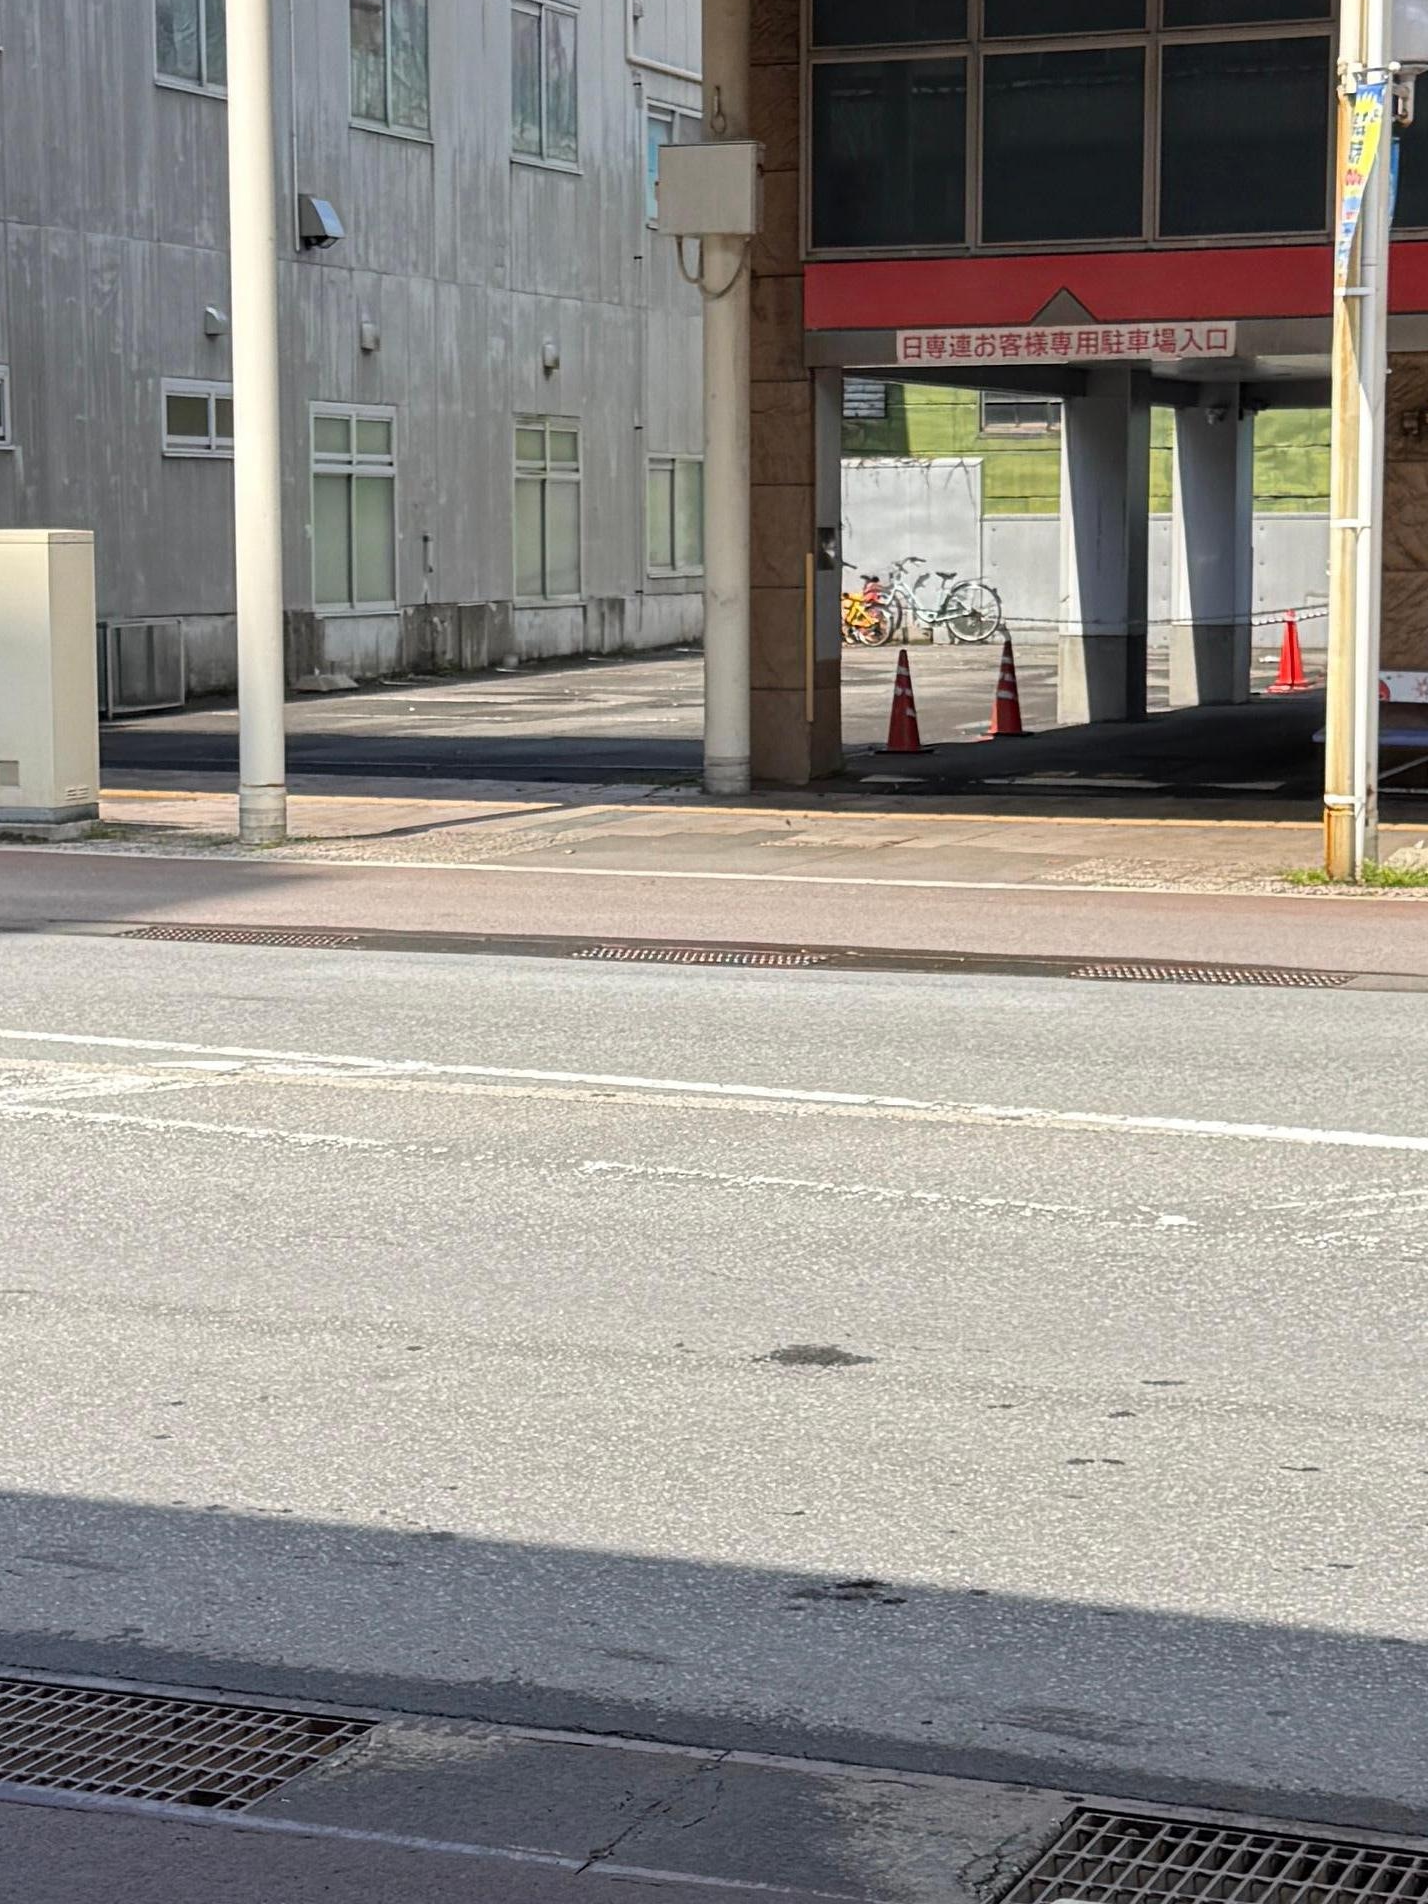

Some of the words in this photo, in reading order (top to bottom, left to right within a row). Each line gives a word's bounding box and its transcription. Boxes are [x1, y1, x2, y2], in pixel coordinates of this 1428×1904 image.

[901, 327, 1229, 361] 日専連お客様専用駐車場入口
